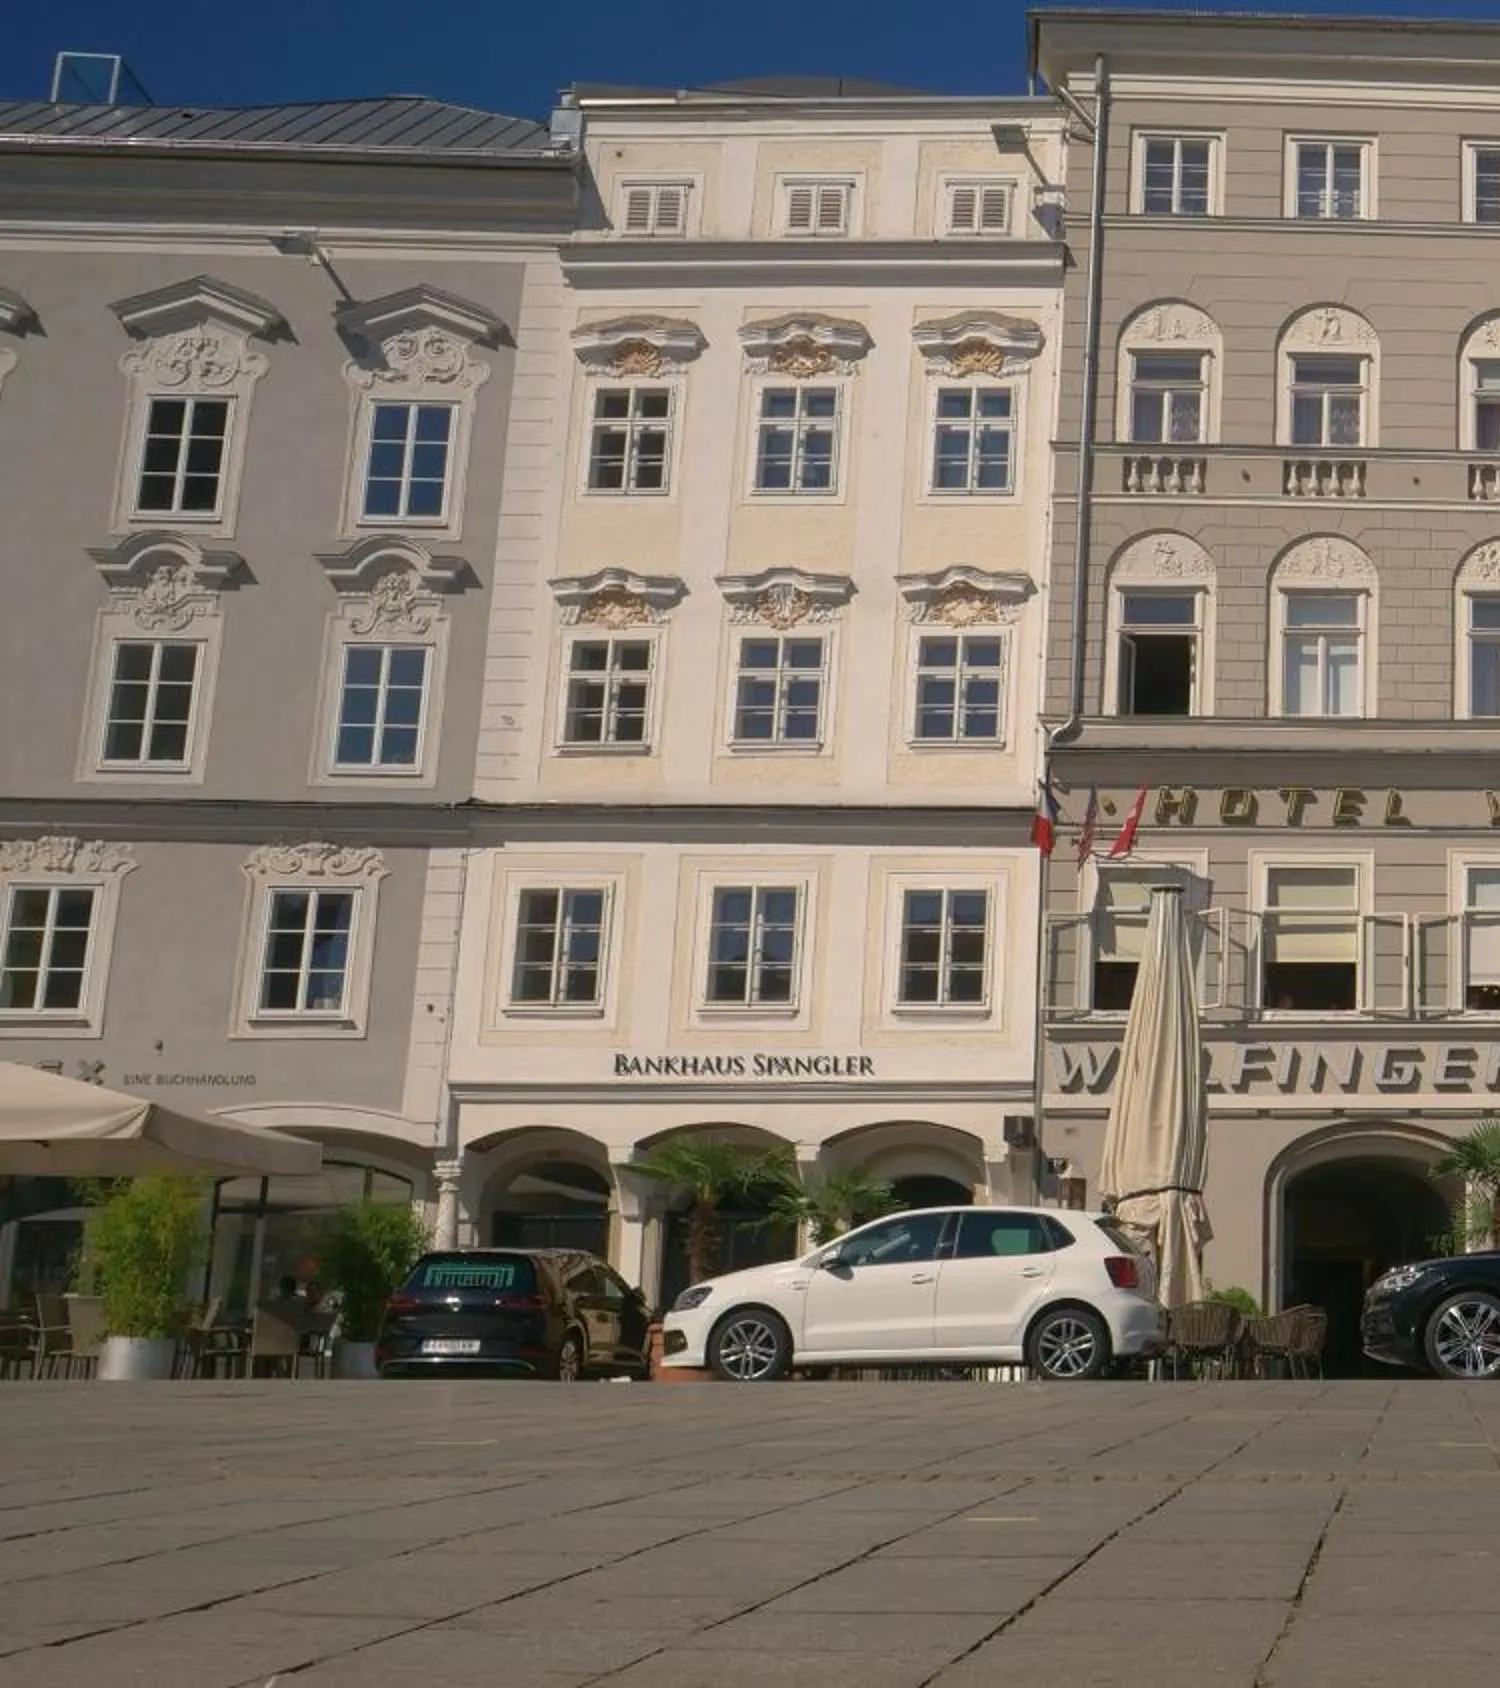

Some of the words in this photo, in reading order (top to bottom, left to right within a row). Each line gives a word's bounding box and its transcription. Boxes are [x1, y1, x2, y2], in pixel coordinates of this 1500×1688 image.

[1155, 785, 1412, 828] HOTEL
[614, 1053, 745, 1077] BANKHAUS
[123, 1074, 152, 1086] EINE
[155, 1073, 257, 1087] BUCHHANDLUNG
